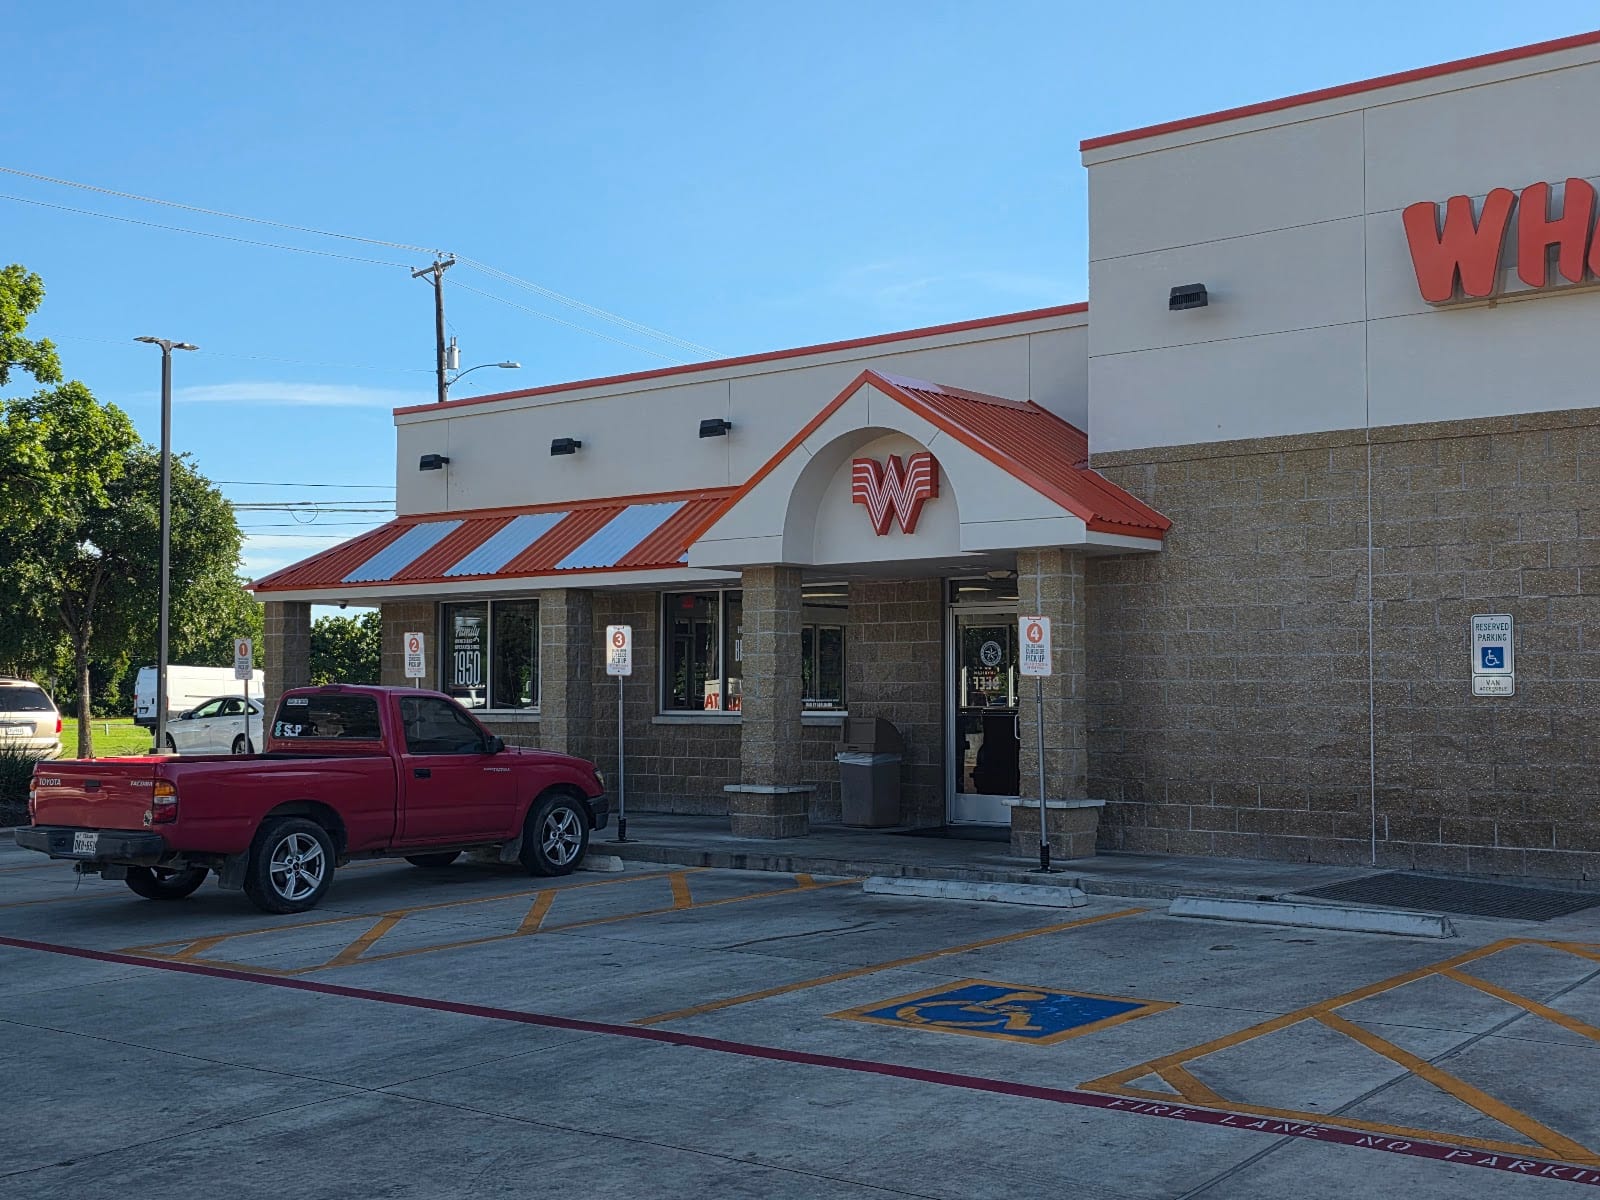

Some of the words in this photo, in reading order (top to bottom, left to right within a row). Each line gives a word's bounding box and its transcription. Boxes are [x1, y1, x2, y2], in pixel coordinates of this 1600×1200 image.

[1402, 177, 1600, 302] WH
[852, 451, 938, 536] W
[1030, 626, 1040, 641] 4
[1475, 622, 1509, 631] RESERVED
[615, 633, 623, 646] 3
[1477, 633, 1507, 642] PARKING
[411, 640, 418, 651] 2
[454, 651, 481, 686] 1950
[1106, 1099, 1196, 1118] FIRE
[1219, 1115, 1329, 1137] LANE
[1356, 1136, 1413, 1151] NO
